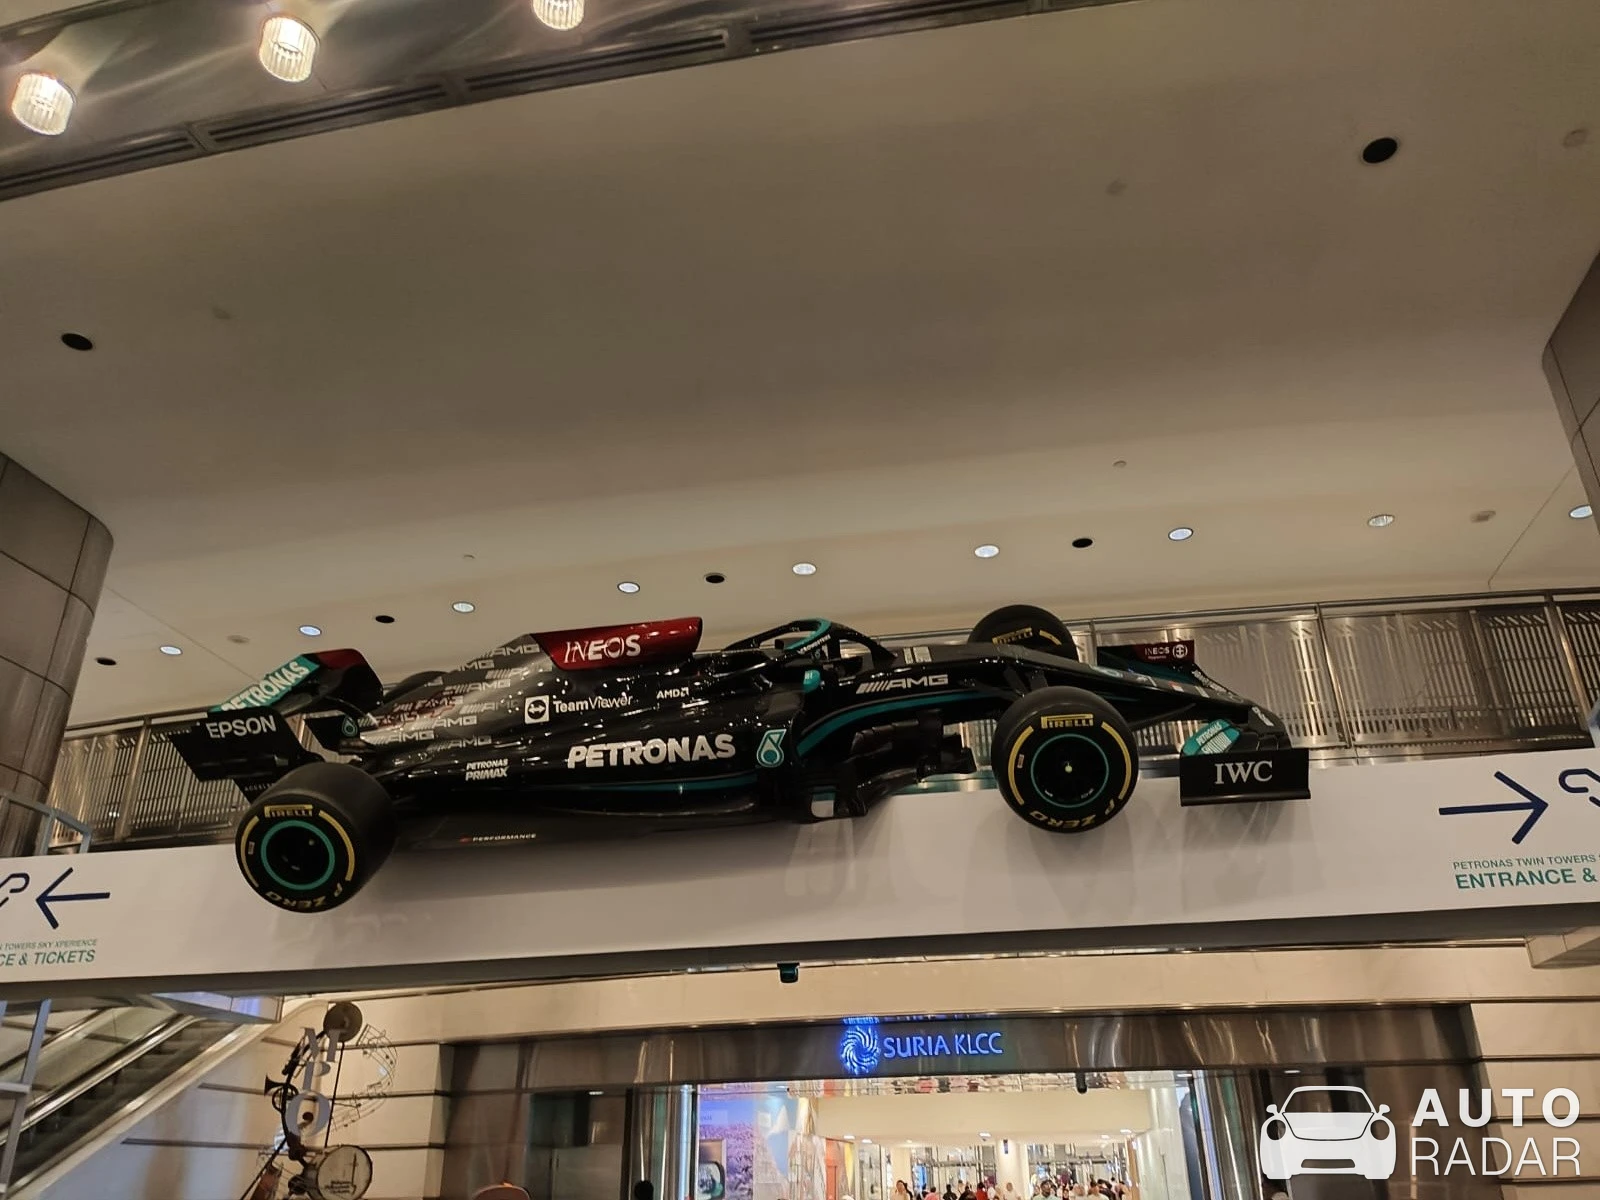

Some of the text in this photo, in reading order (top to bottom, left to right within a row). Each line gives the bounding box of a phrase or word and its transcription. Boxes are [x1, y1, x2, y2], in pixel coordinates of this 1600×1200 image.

[490, 644, 540, 656] AMG
[564, 634, 641, 663] INEOS
[1144, 646, 1170, 655] INEOS
[885, 674, 949, 691] AMG
[657, 688, 680, 700] AMD
[553, 695, 633, 713] TeamViewer
[205, 715, 277, 739] EPSON
[432, 715, 478, 730] AMG
[1041, 713, 1094, 729] PIRELLI
[567, 734, 736, 769] PETRONAS
[466, 758, 509, 770] PETRONAS
[465, 766, 510, 781] PRIMAX
[1214, 760, 1273, 785] IWC
[264, 804, 313, 818] PIRELLI
[1453, 854, 1596, 870] PETRONAS TWIN TOWERS
[1455, 867, 1598, 889] ENTRANCE &
[18, 952, 28, 966] &
[34, 949, 96, 965] TICKETS
[883, 1032, 1003, 1058] SURIA KLCC
